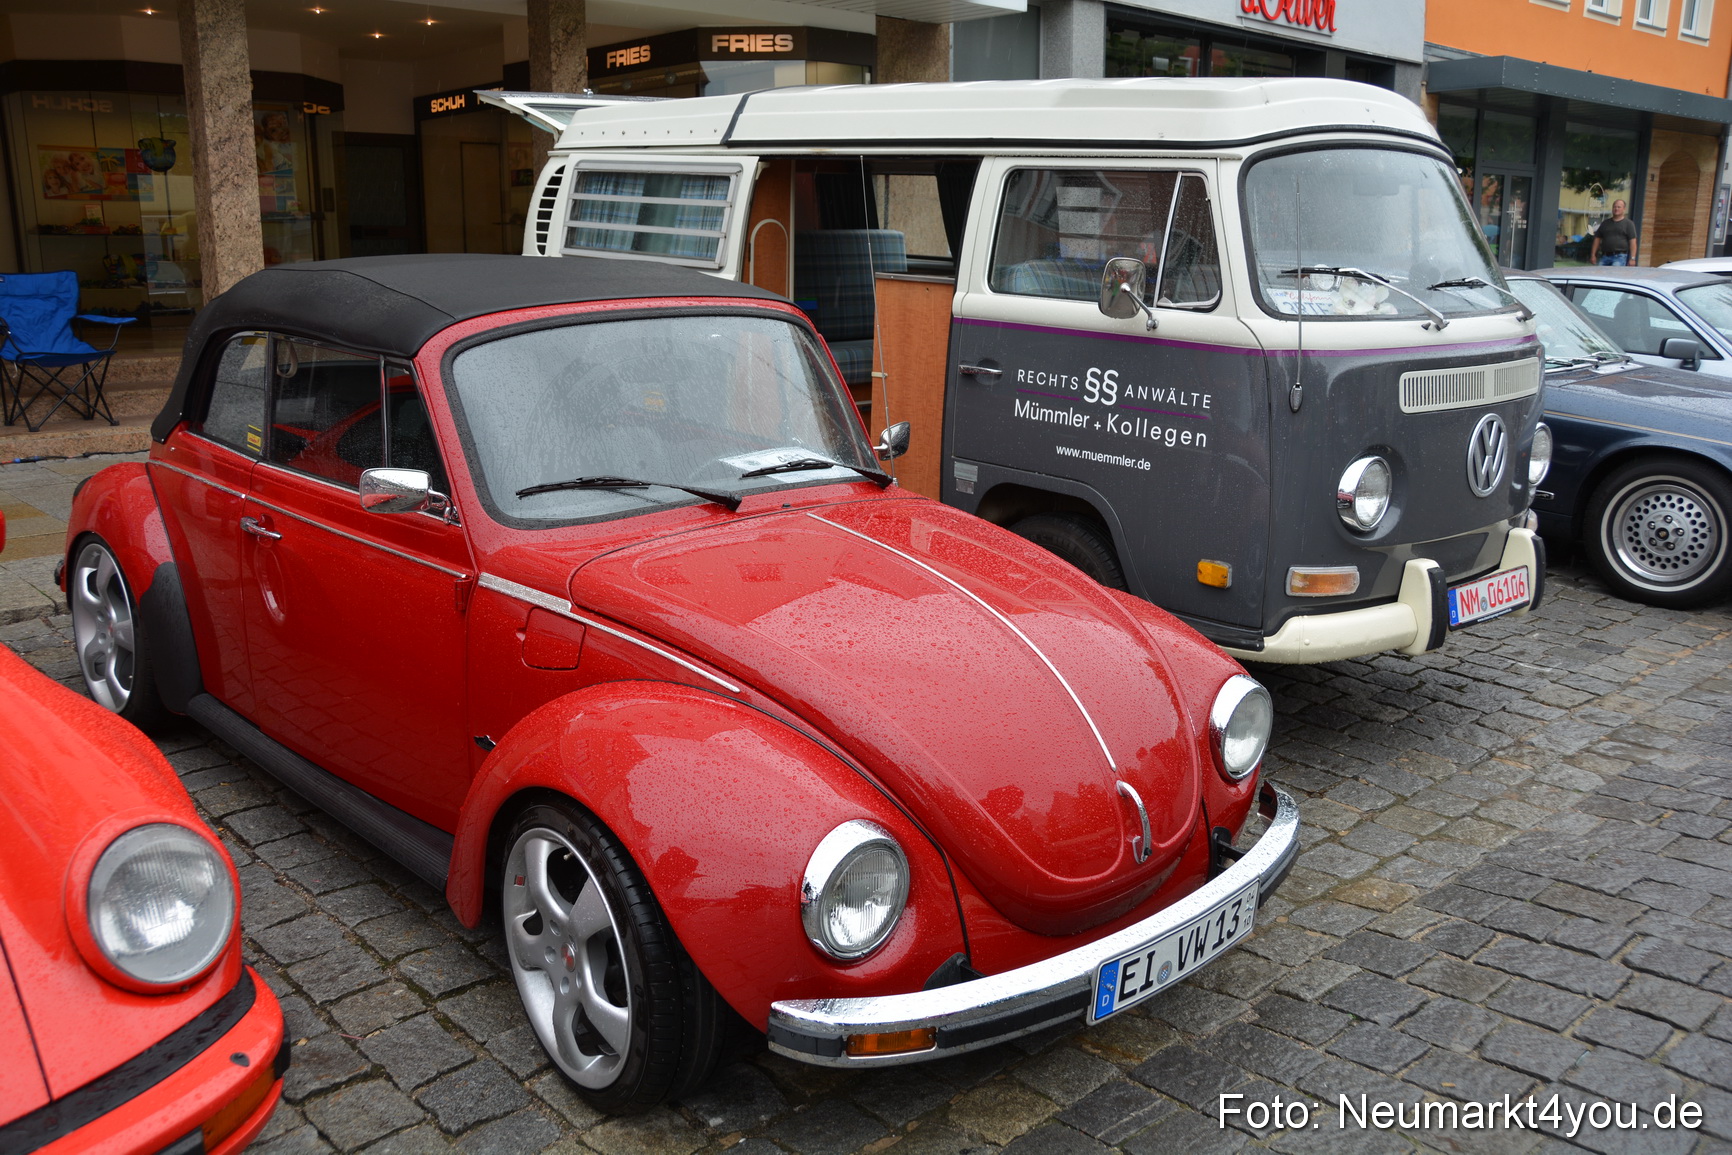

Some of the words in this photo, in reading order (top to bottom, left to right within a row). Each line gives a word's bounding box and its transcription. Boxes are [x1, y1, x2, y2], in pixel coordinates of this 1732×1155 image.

[606, 43, 651, 69] FRIES
[711, 33, 794, 53] FRIES
[430, 94, 465, 114] SCHUH
[1017, 368, 1079, 390] RECHTS
[1124, 384, 1212, 409] ANWÄLTE
[1014, 398, 1090, 429] Mümmler
[1093, 420, 1102, 431] +
[1106, 412, 1207, 448] Kollegen
[1055, 444, 1151, 471] www.muemmler.de
[1459, 587, 1481, 617] NM
[1487, 572, 1525, 608] 06106
[1101, 994, 1110, 1007] D
[1118, 950, 1156, 1002] EI
